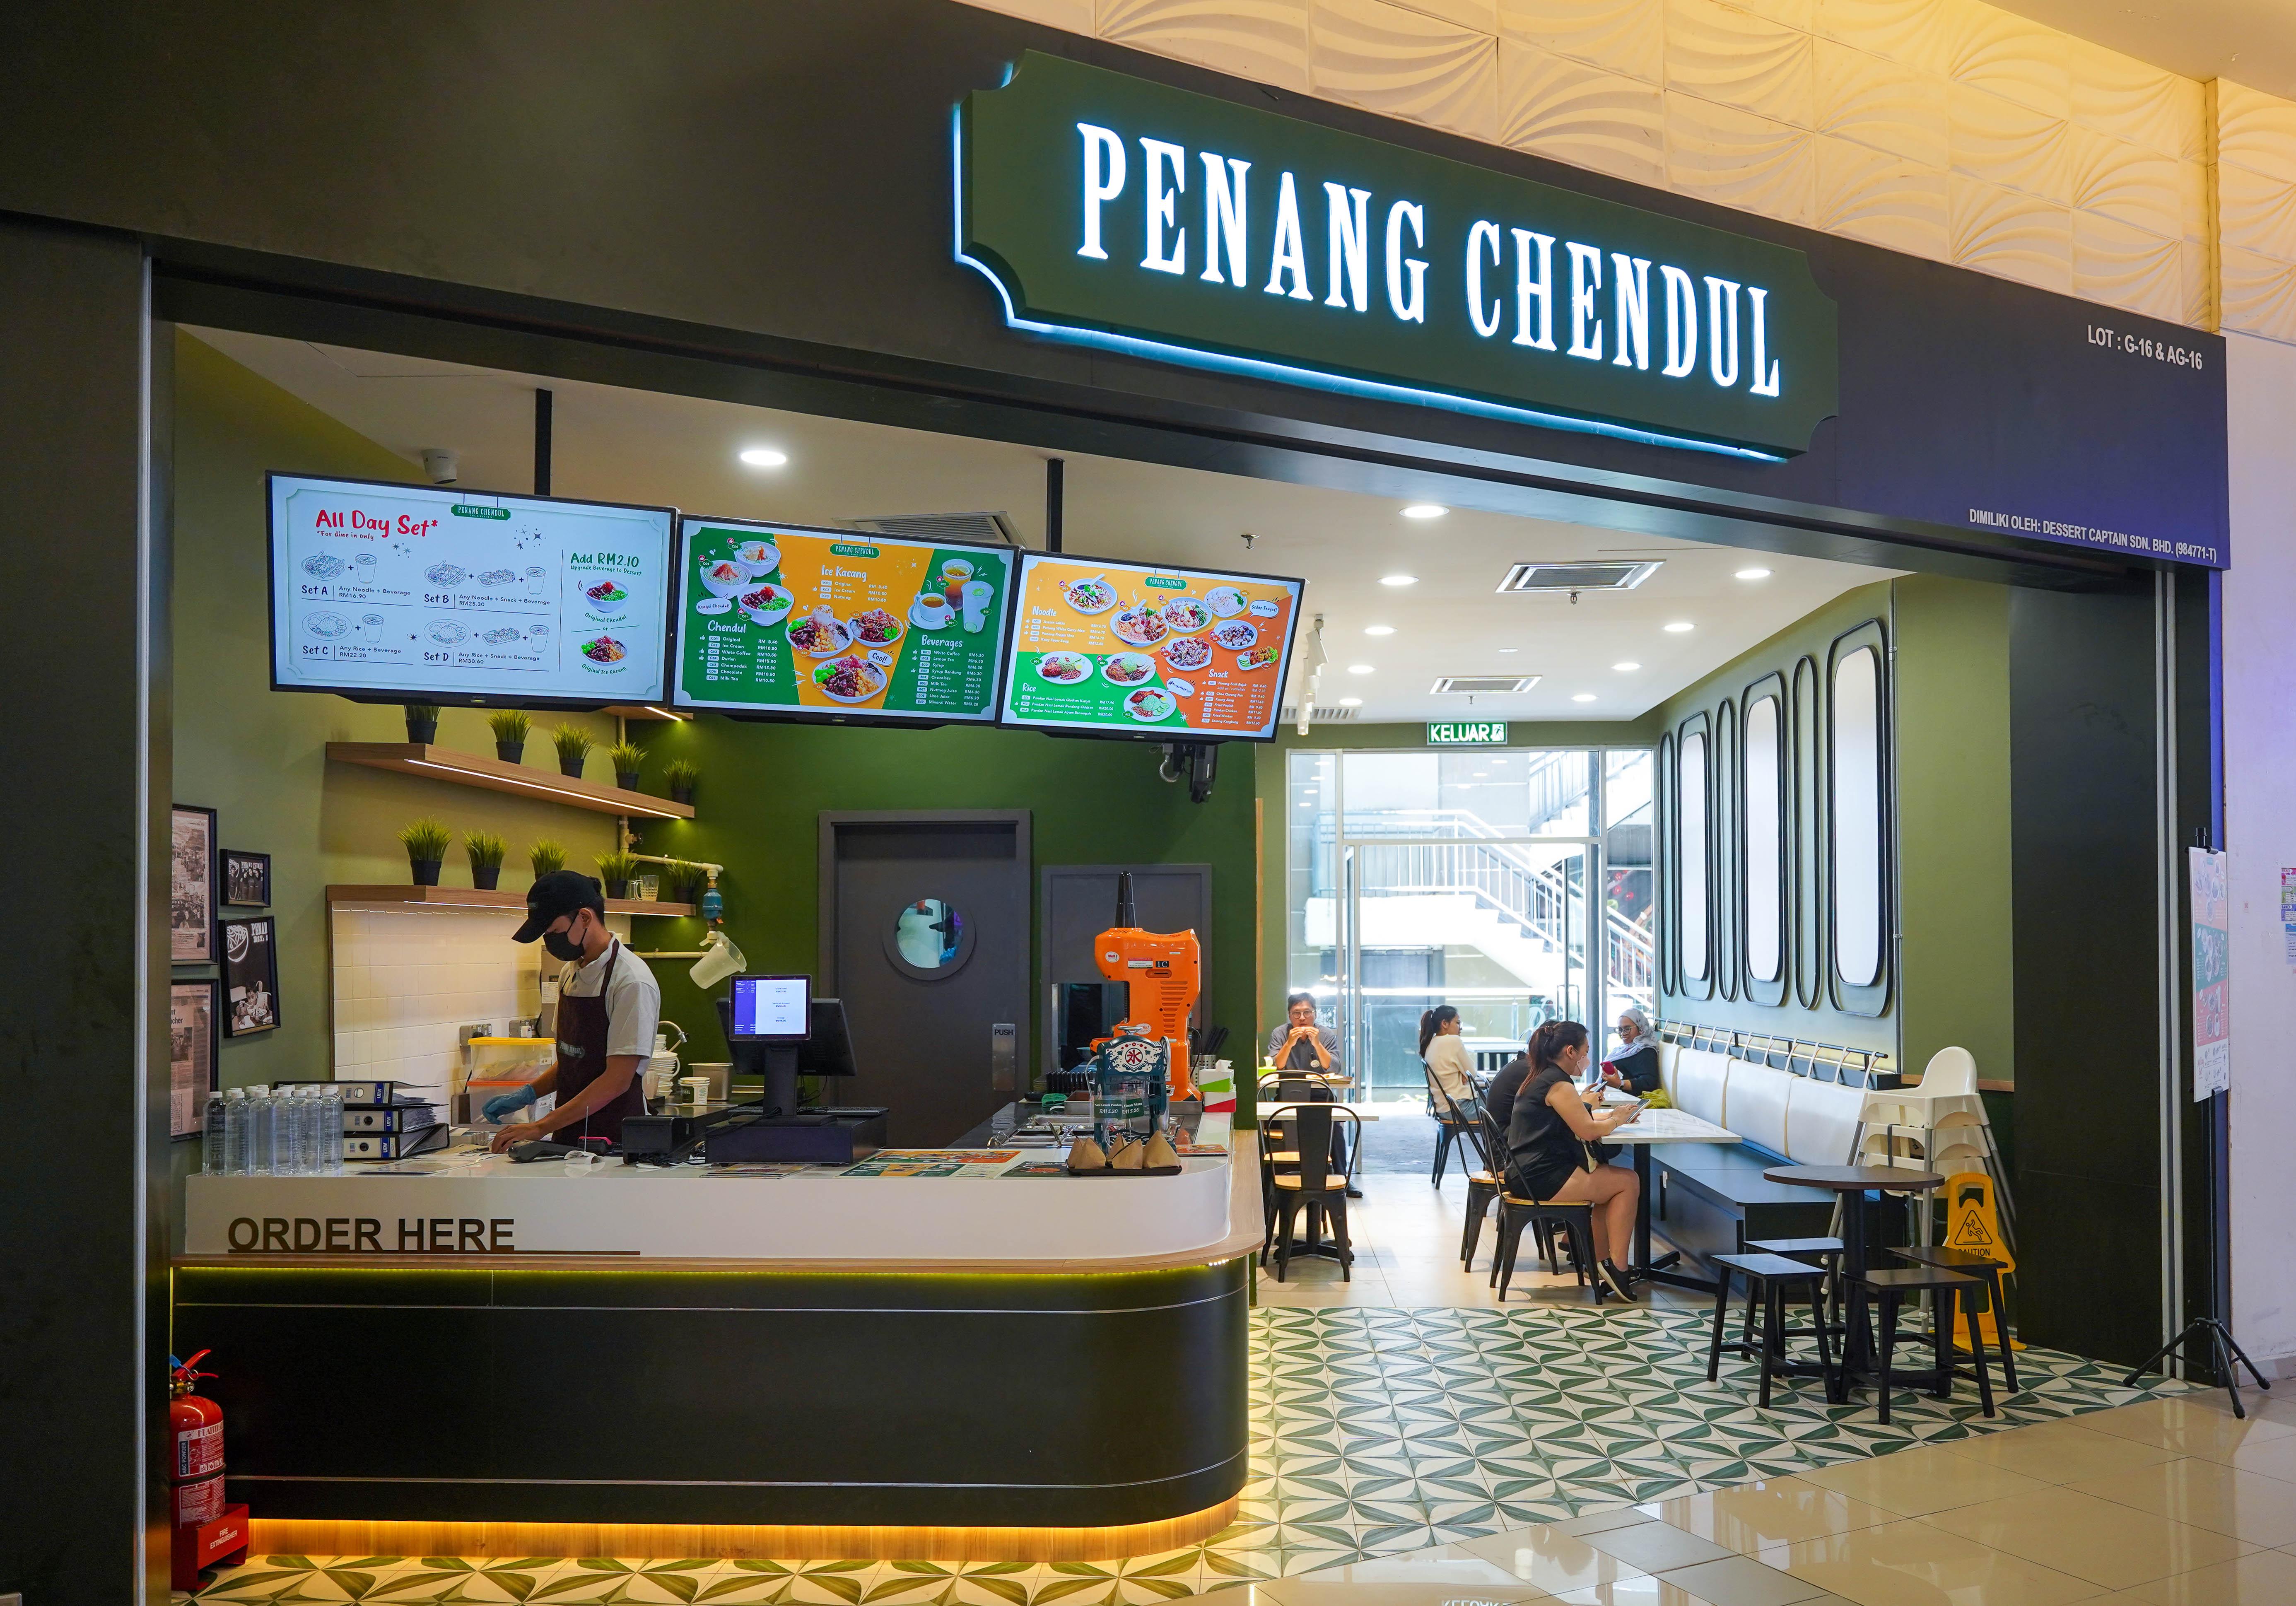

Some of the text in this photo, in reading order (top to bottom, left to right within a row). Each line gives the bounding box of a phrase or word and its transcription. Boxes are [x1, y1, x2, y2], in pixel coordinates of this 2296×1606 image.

[1076, 122, 1780, 398] PENANG CHENDUL
[2088, 325, 2114, 347] LOT
[2125, 335, 2152, 357] G-16
[2155, 342, 2164, 361] &
[2167, 345, 2202, 370] AG-16
[458, 506, 479, 514] PENANG
[481, 508, 504, 517] CHENDUL
[316, 509, 344, 528] All
[352, 510, 390, 538] Day
[1970, 509, 2217, 564] DIMILIKI OLEH: DESSERT CAPTAIN SDN. BHD. (984771-T)
[571, 552, 639, 567] Add RM2.10
[821, 564, 867, 583] Ice Kacang
[301, 585, 328, 595] Set A
[424, 593, 449, 603] Set B
[1032, 606, 1057, 616] Noodle
[585, 612, 605, 622] Original
[708, 620, 746, 633] Chendul
[921, 634, 963, 650] Beverages
[302, 645, 328, 655] Set C
[424, 652, 449, 661] Set D
[872, 653, 888, 663] Cool!
[582, 663, 600, 674] Original
[1209, 669, 1228, 678] Snack
[1023, 682, 1036, 692] Rice
[1430, 724, 1490, 742] KELUAR
[228, 1217, 515, 1252] ORDER HERE
[219, 1527, 228, 1537] FIRE
[210, 1530, 237, 1550] EXTINGUISHER
